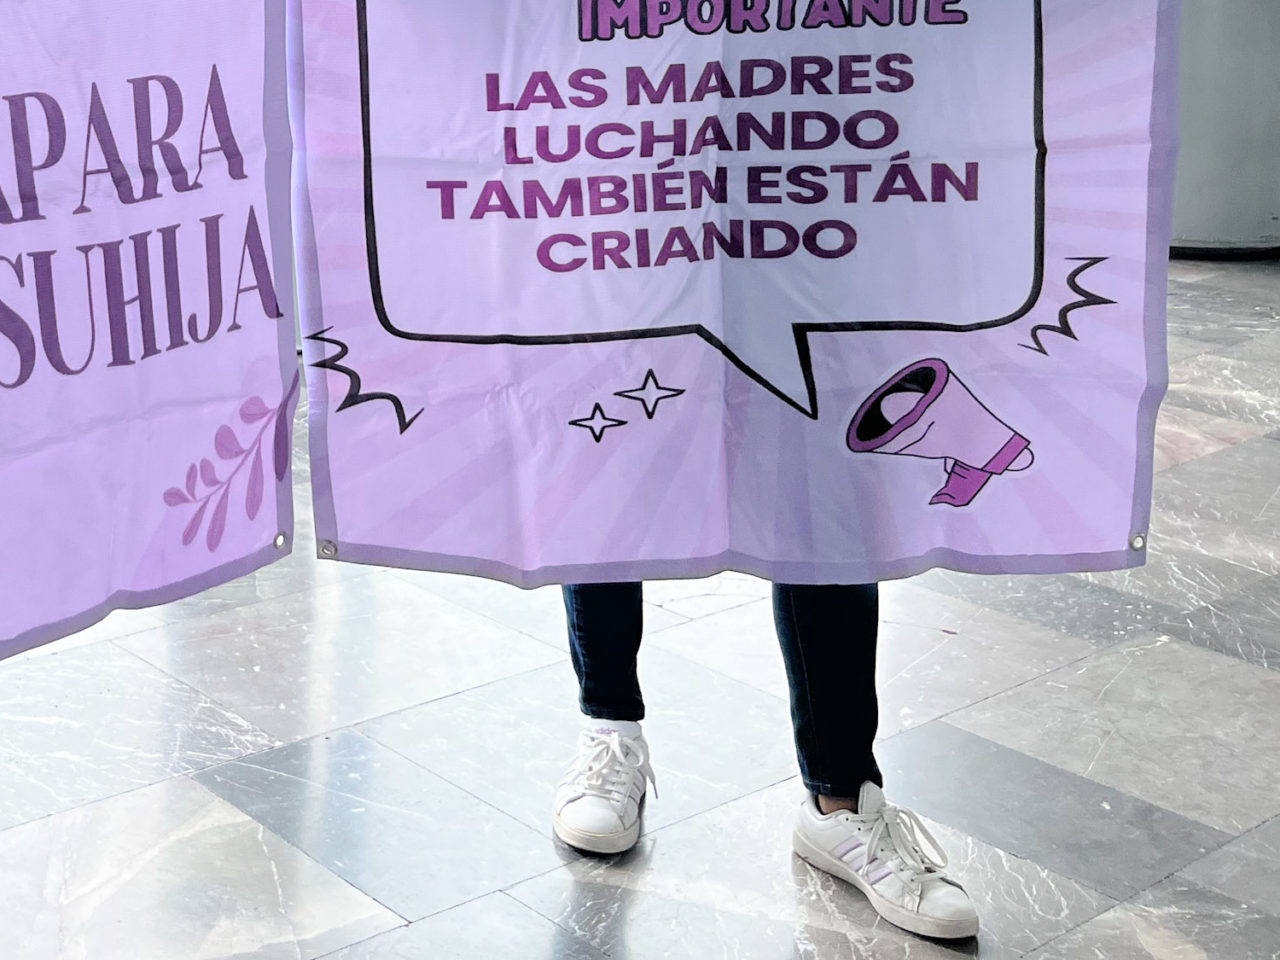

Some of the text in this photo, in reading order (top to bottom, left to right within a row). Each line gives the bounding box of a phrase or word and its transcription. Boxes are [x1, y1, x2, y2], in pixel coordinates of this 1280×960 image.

[485, 52, 914, 113] LAS MADRES
[504, 110, 900, 166] LUCHANDO
[426, 151, 979, 220] TAMBIÉN ESTÁN
[536, 219, 858, 273] CRIANDO
